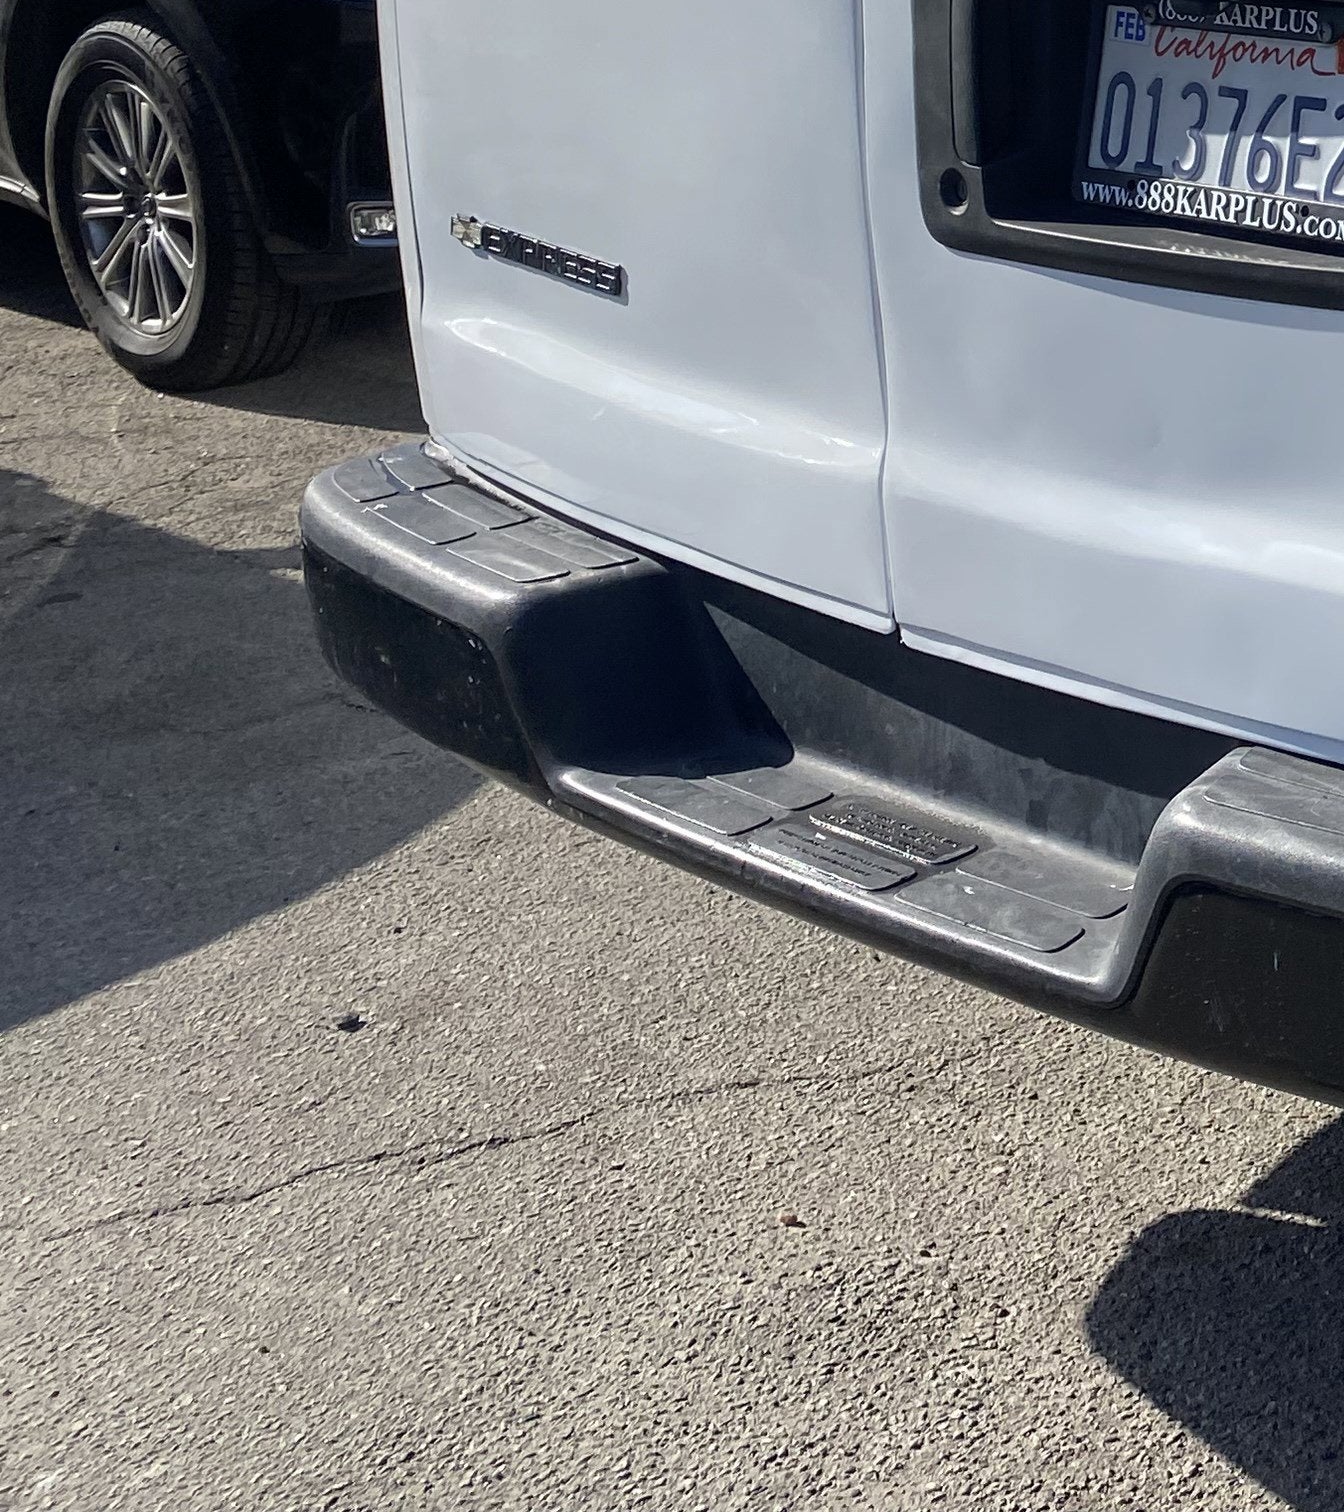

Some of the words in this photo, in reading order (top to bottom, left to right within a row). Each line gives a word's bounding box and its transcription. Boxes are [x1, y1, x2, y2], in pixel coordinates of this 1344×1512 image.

[1114, 10, 1147, 41] FEB
[1213, 1, 1319, 35] KARPLUS
[1154, 25, 1336, 79] California
[482, 221, 622, 296] EXPRESS
